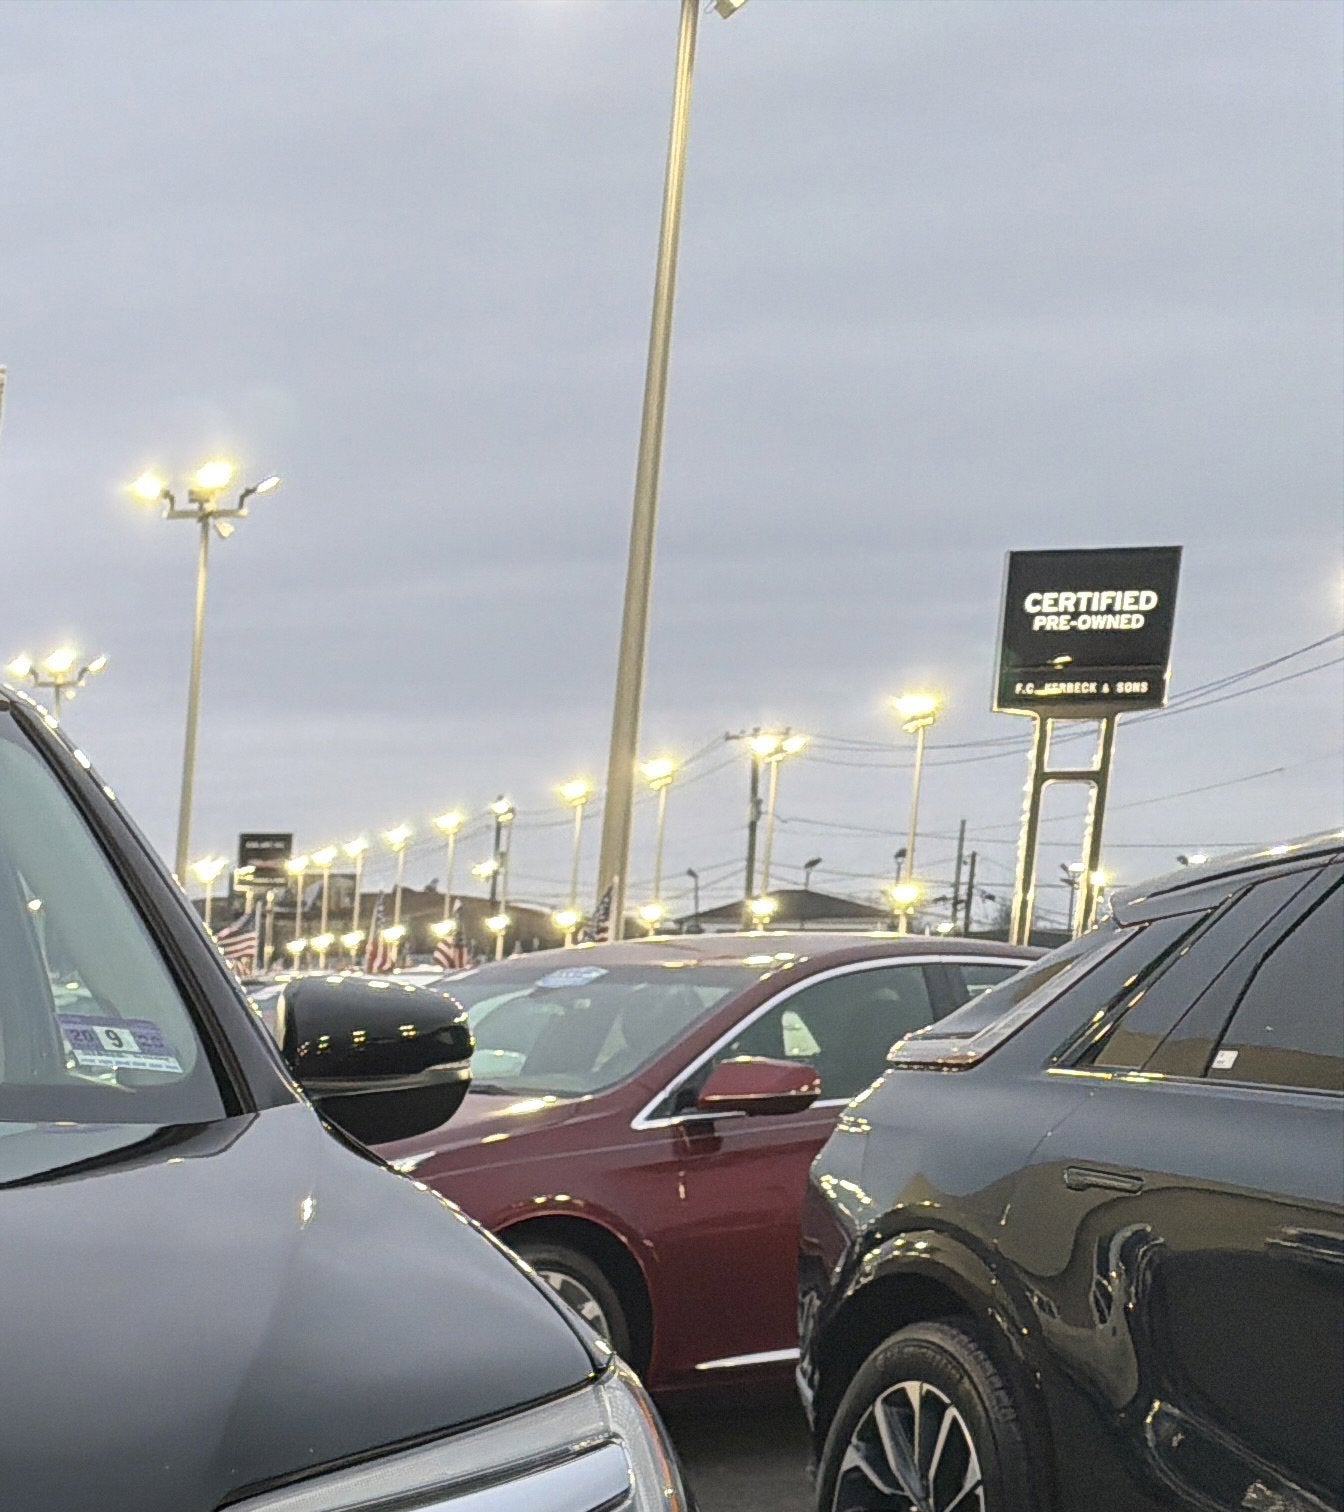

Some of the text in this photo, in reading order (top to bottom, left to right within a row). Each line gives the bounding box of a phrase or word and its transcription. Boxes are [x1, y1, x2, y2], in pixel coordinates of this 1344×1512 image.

[1024, 590, 1158, 613] CERTIFIED
[1032, 613, 1145, 631] PRE-OWNED
[1014, 682, 1038, 695] F.C
[1116, 681, 1149, 693] SONS
[104, 1029, 124, 1048] 9
